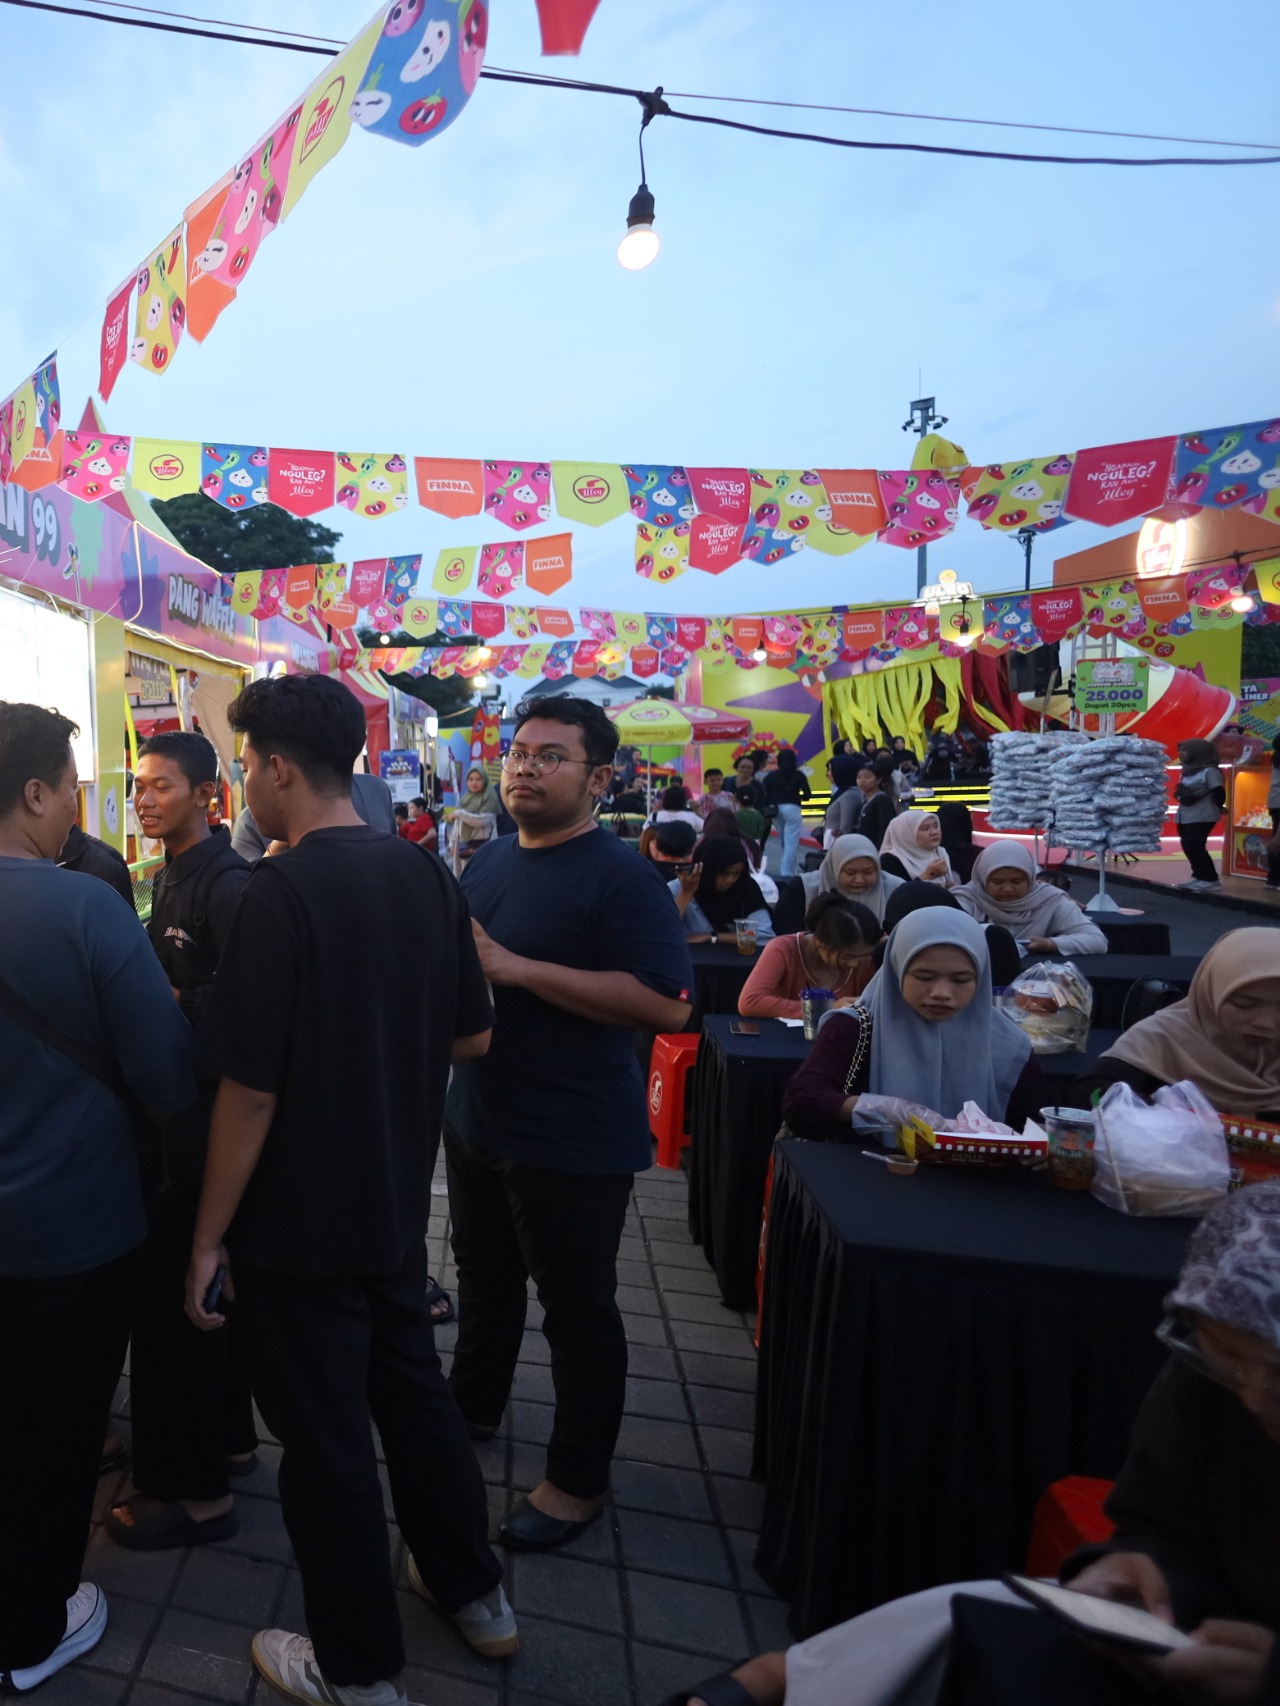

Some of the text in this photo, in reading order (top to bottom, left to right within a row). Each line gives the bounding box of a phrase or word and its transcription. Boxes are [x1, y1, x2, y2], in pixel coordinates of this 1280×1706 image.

[279, 469, 326, 483] NGULEG?
[1087, 460, 1157, 481] NGULEG?
[428, 481, 472, 493] FINNA
[701, 483, 746, 496] NGULEG?
[1100, 478, 1138, 490] KAN ADA
[833, 493, 874, 505] FINNA
[1097, 486, 1135, 505] Uleg
[32, 501, 58, 552] 99
[534, 558, 562, 570] FINNA
[1146, 593, 1178, 604] FINNA
[168, 575, 235, 638] PANG WAFFLE
[1038, 599, 1073, 611] NGULEG?
[849, 624, 874, 633] FINNA
[1086, 689, 1144, 702] 25.000
[1085, 702, 1109, 710] Dapat
